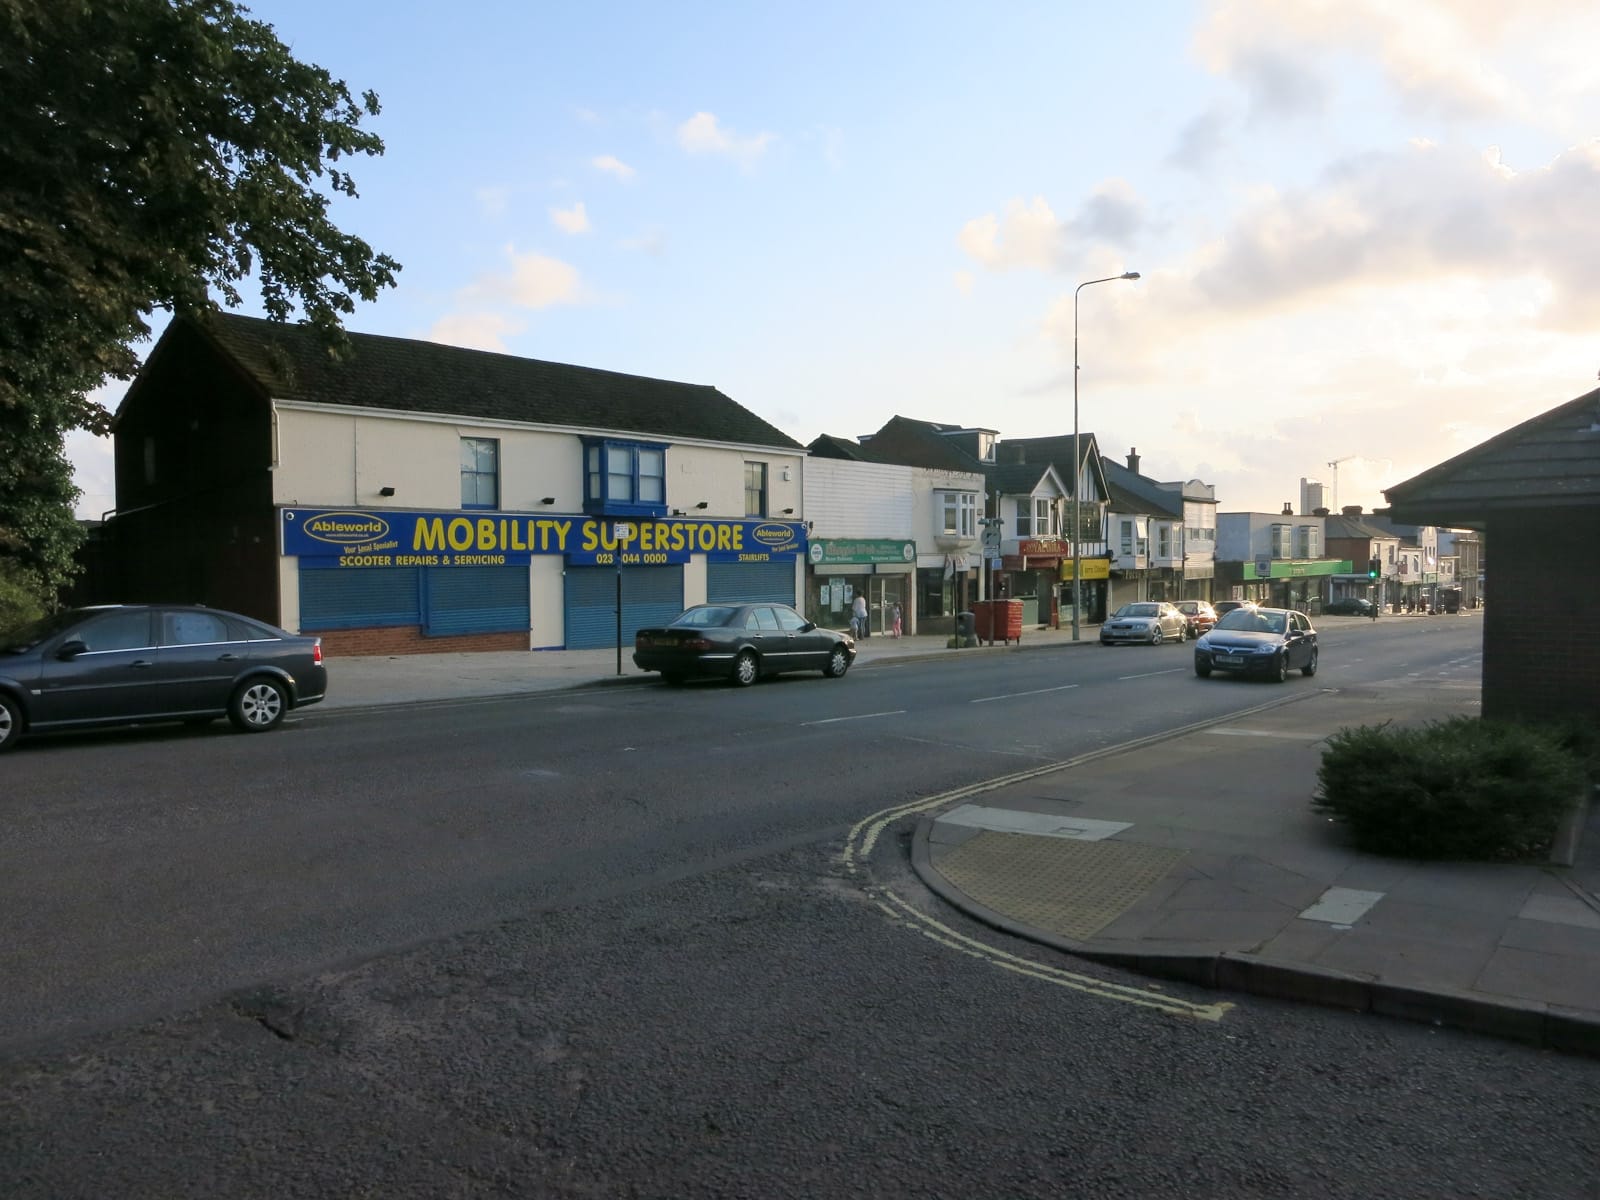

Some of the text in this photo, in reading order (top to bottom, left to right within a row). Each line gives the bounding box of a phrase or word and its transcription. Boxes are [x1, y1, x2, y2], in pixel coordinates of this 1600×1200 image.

[312, 520, 382, 532] Ableworld
[413, 517, 572, 551] MOBILITY
[582, 521, 743, 551] SUPERSTORE
[757, 529, 790, 537] Ableworld
[340, 554, 505, 566] SCOOTER REPAIRS & SERVICING
[596, 553, 614, 564] 023
[643, 553, 667, 564] 0000
[738, 553, 769, 561] STAIRLIFTS
